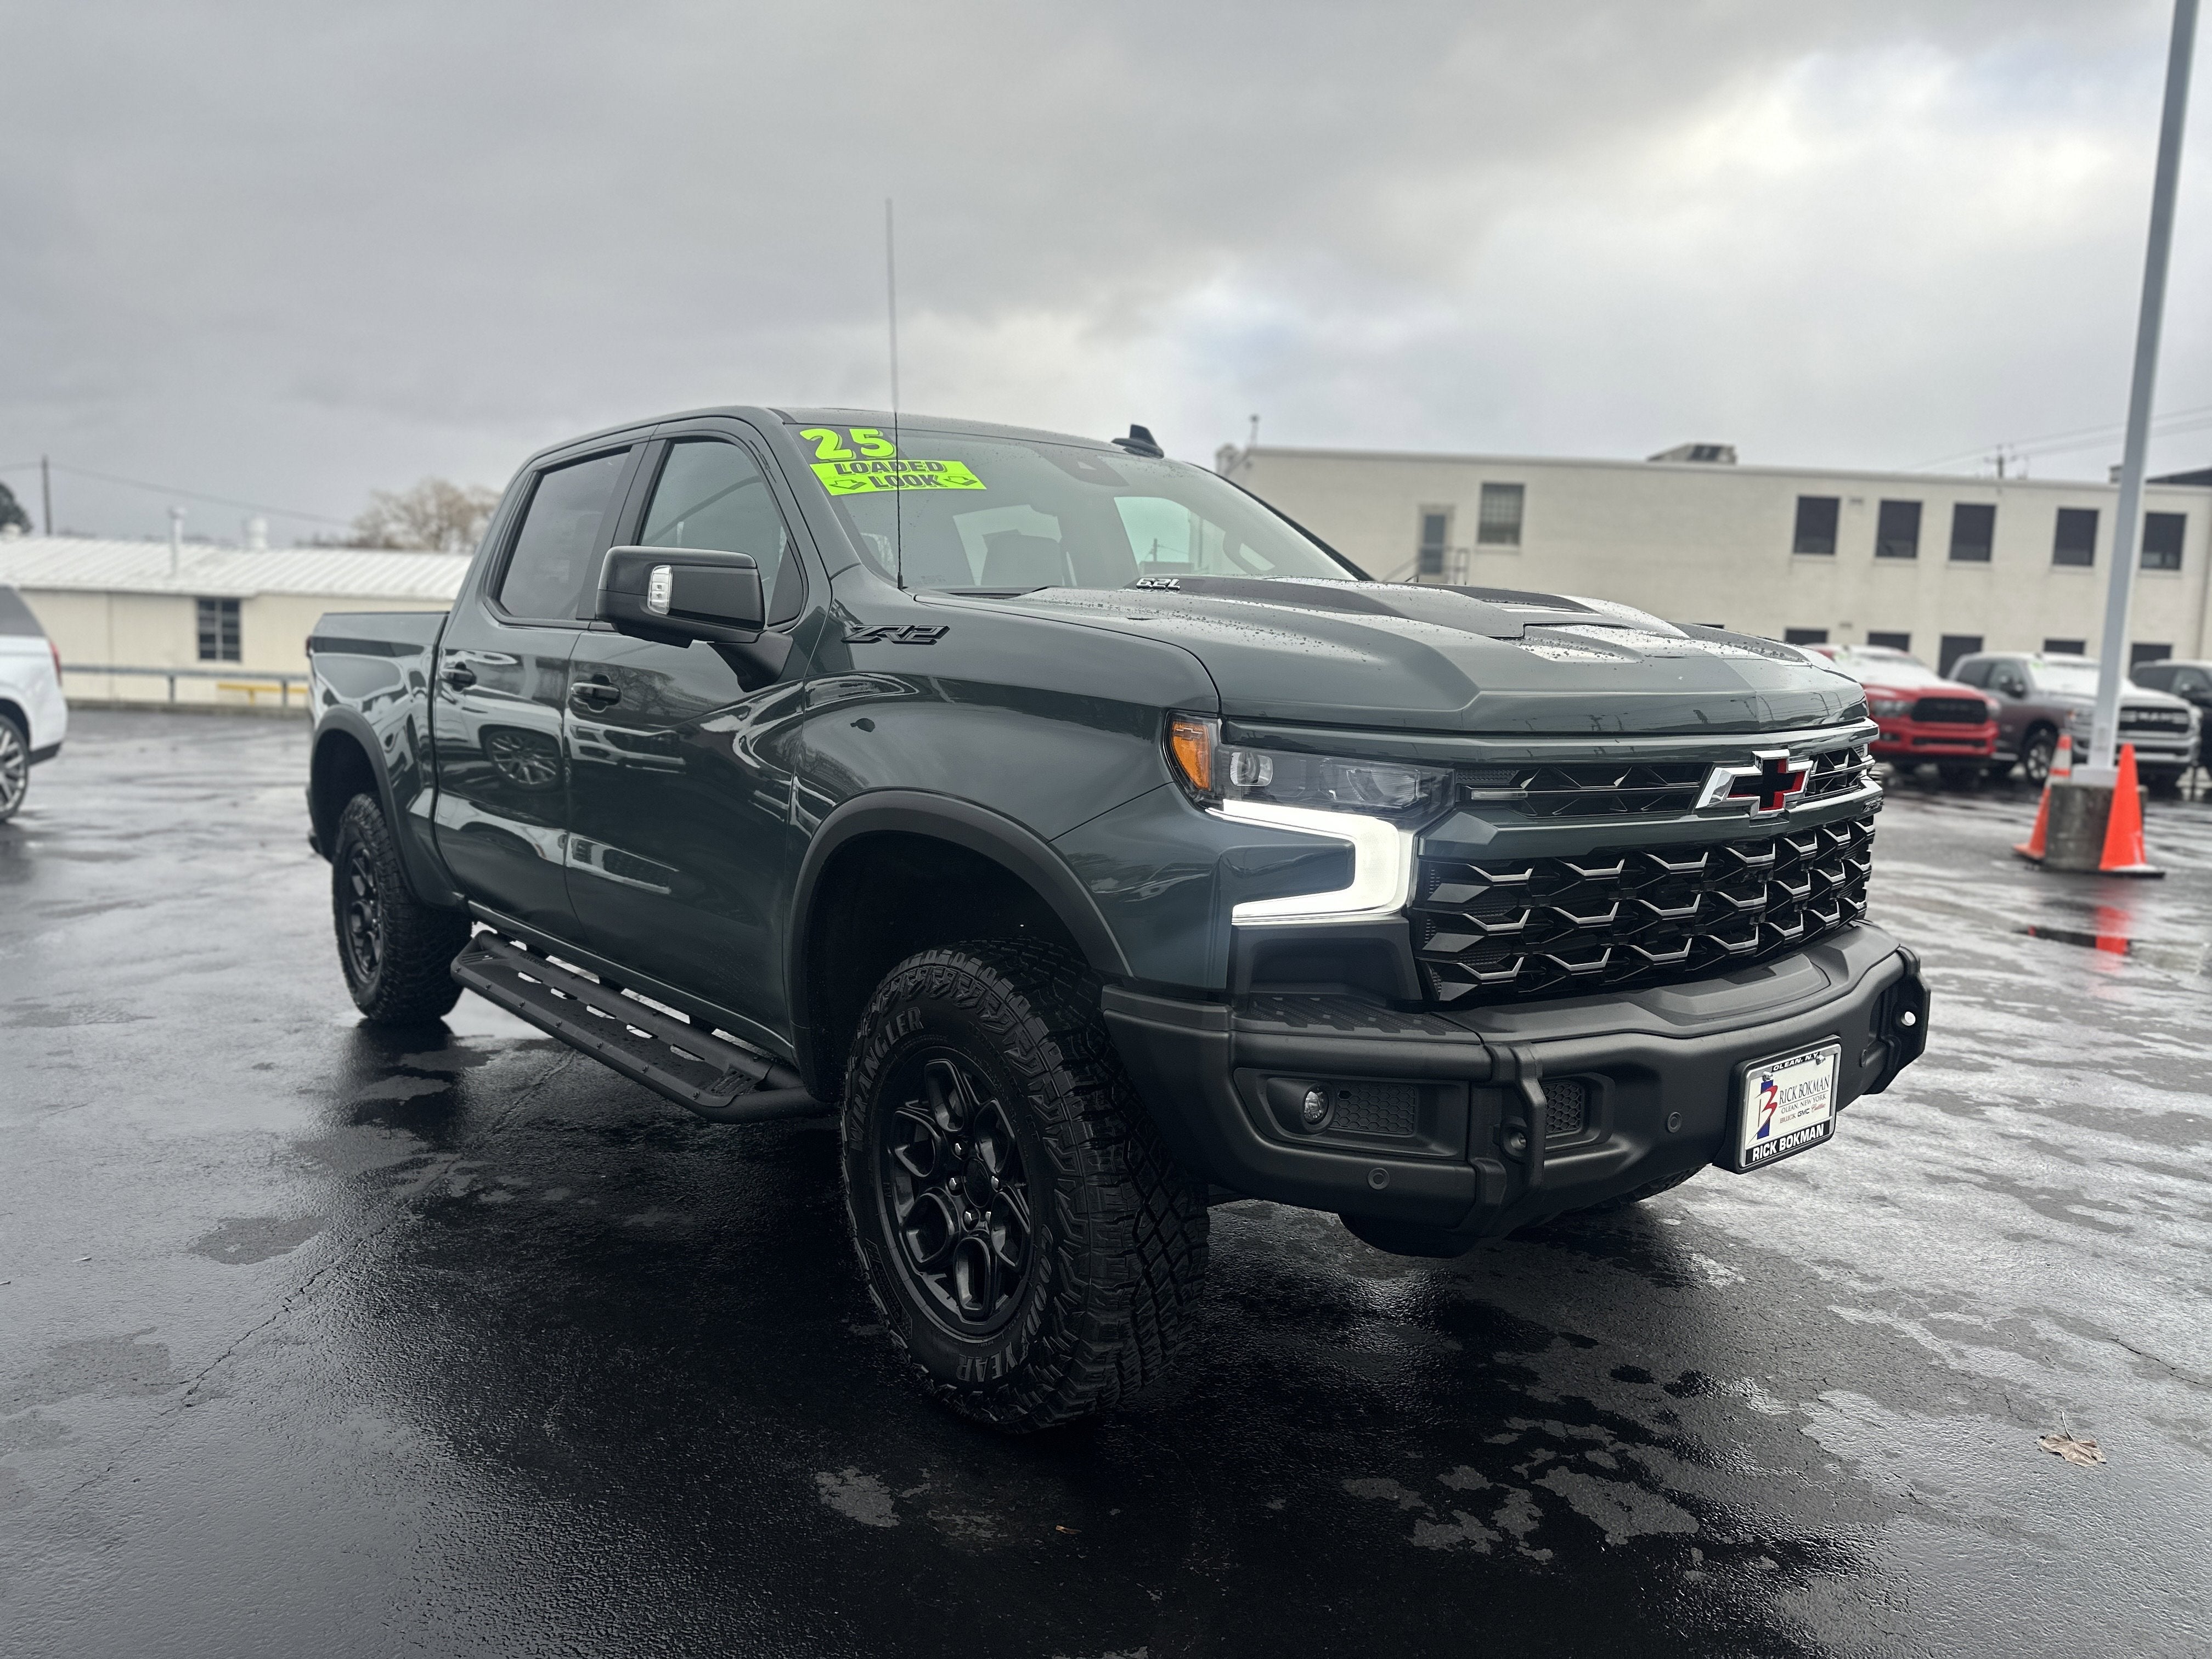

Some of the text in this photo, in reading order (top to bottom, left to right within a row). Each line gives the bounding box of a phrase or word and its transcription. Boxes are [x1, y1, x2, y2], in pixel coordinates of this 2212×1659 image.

[800, 428, 897, 460] 25
[833, 461, 947, 476] LOADED
[868, 474, 947, 489] LOOK
[840, 624, 950, 645] ZR2
[850, 1006, 923, 1152] WRANGLER
[1779, 1075, 1830, 1105] RICK BOKMAN
[1800, 1098, 1812, 1108] NEW
[1813, 1093, 1826, 1103] YORK
[1780, 1113, 1796, 1124] BUICK
[1797, 1108, 1810, 1118] GMC
[1752, 1123, 1825, 1162] RICK BOKMAN
